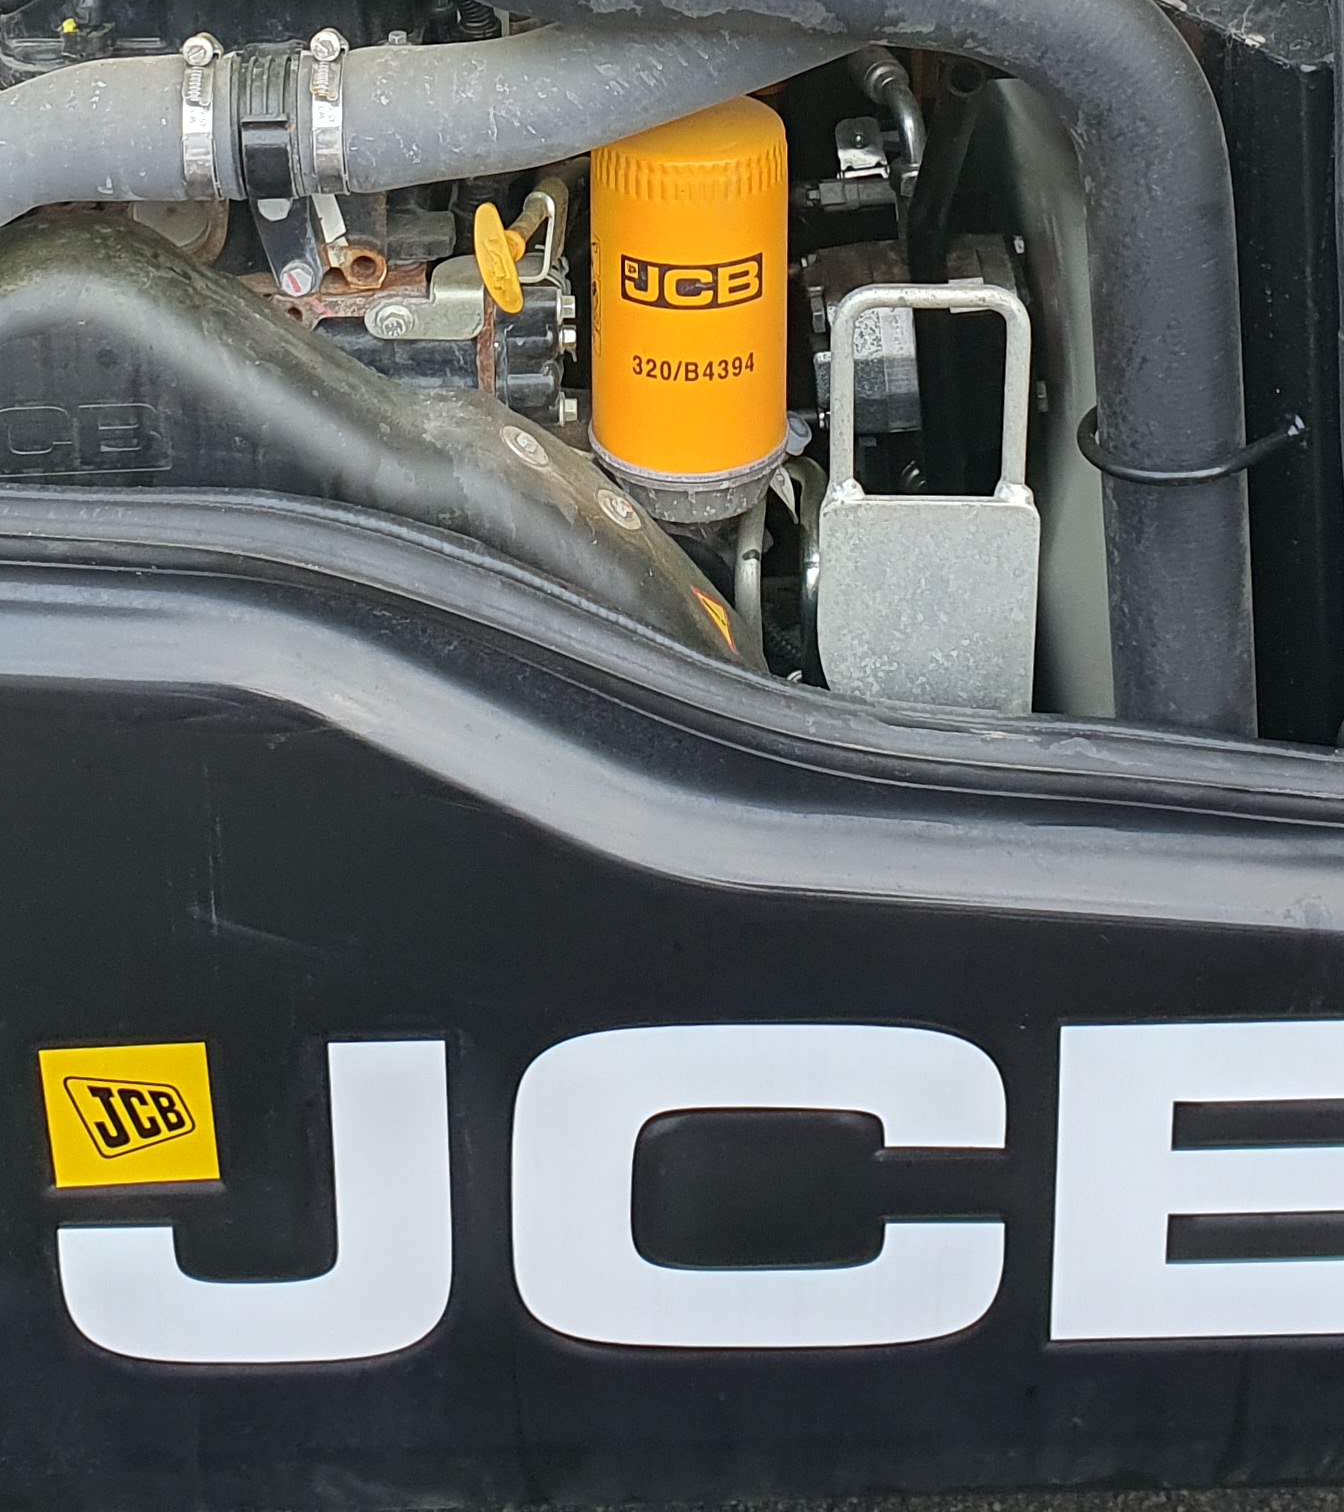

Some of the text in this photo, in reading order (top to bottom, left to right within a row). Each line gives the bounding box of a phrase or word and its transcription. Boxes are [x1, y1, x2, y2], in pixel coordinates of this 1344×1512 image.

[623, 259, 760, 307] JCB
[632, 351, 755, 382] 320/B4394
[87, 1085, 186, 1149] JCB
